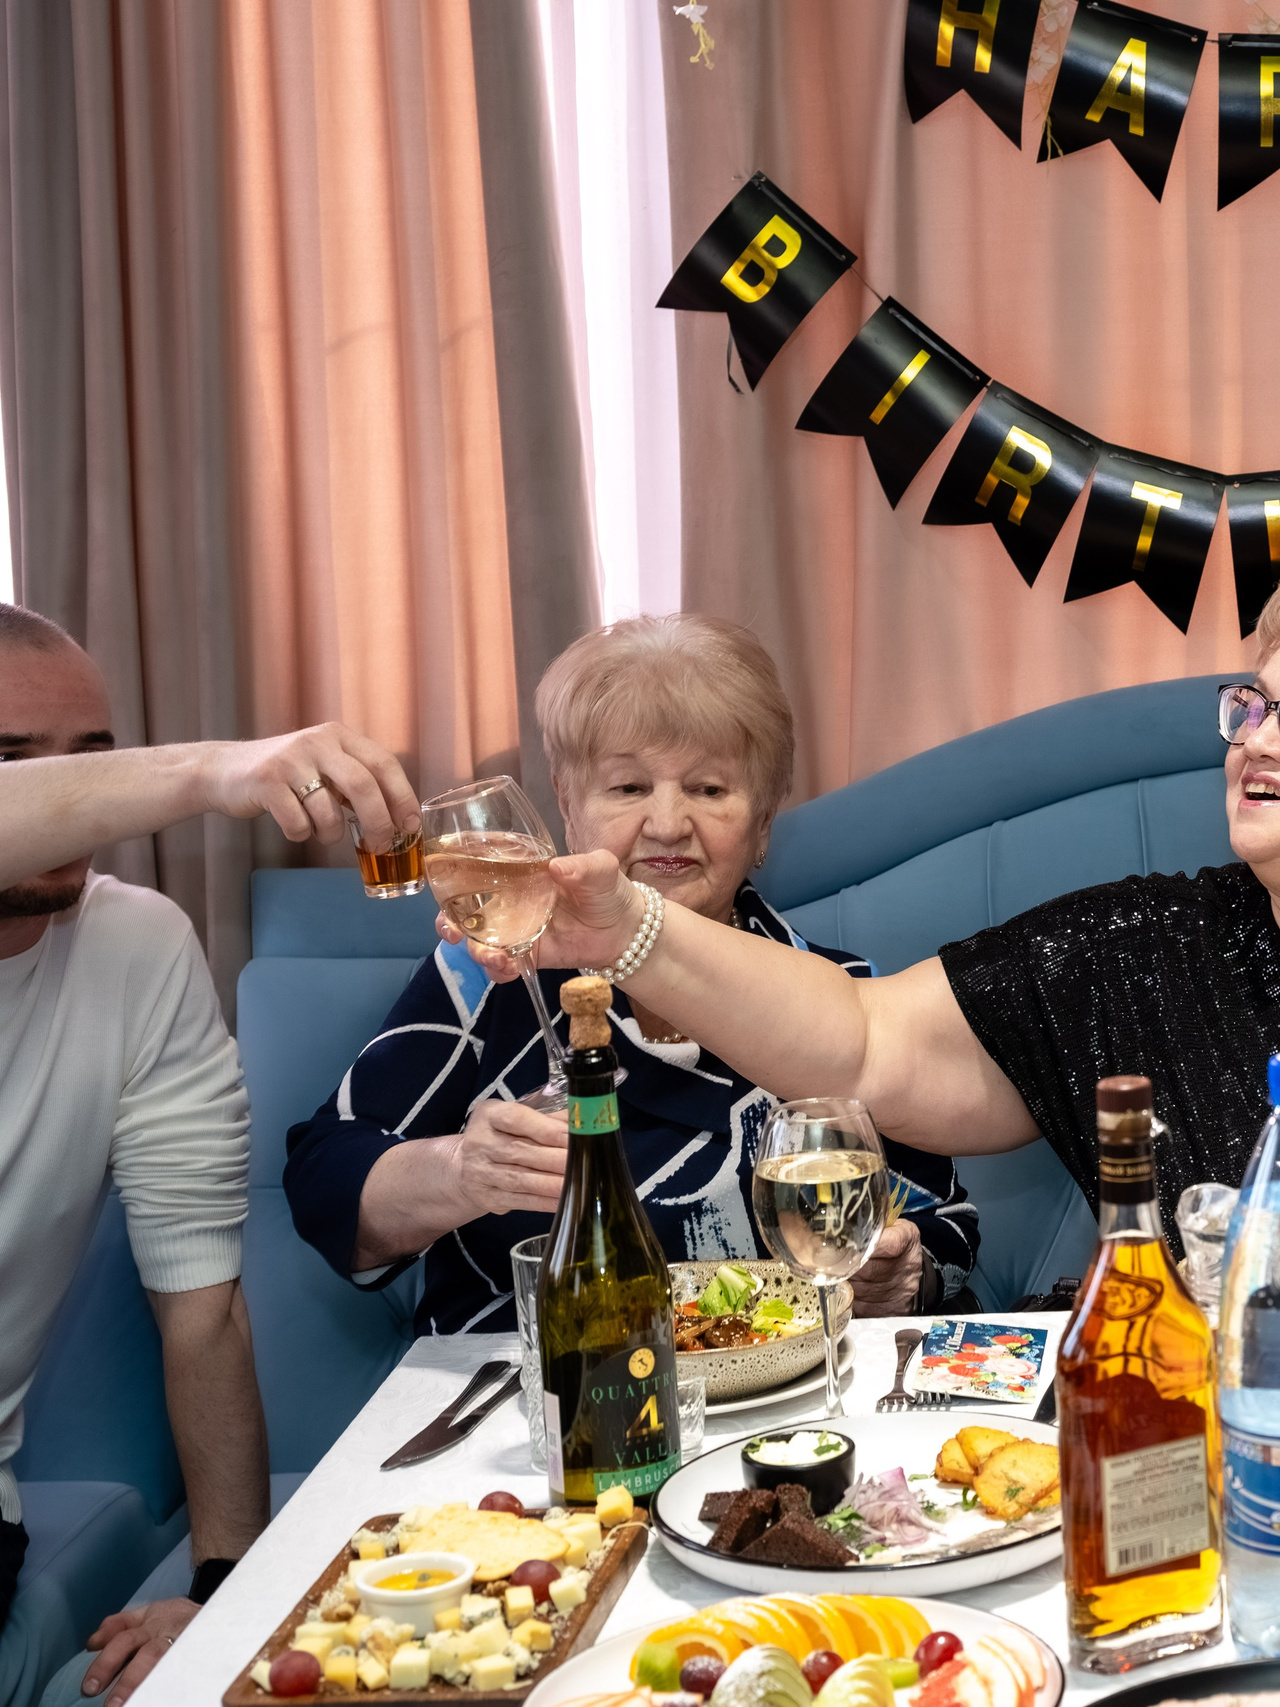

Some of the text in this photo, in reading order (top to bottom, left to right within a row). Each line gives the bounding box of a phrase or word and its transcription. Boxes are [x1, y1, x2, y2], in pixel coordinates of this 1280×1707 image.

[591, 1368, 677, 1404] QUATTRO
[625, 1394, 665, 1446] 4
[598, 1461, 681, 1492] LAMBRUSCO
